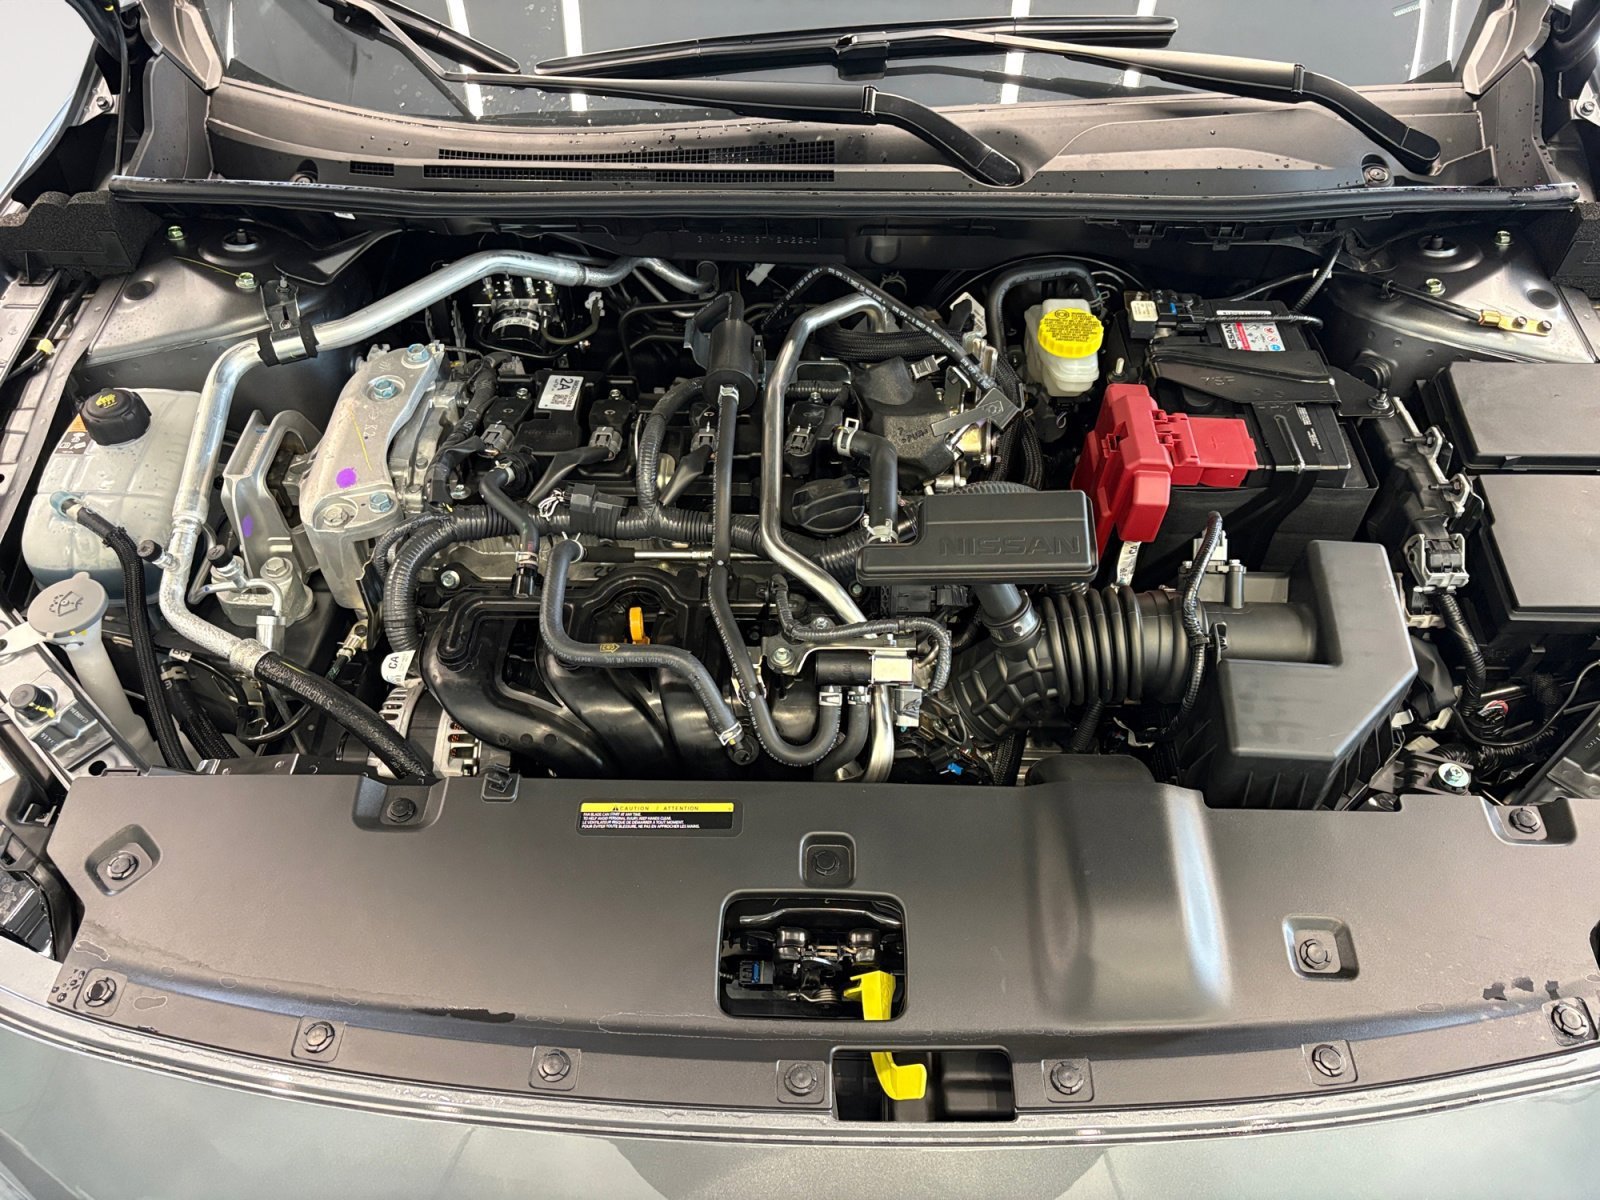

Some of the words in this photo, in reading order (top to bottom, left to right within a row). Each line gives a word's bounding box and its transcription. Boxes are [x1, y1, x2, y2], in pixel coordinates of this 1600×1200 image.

[557, 377, 574, 391] 2A
[938, 535, 1081, 557] NISSAN
[388, 655, 400, 670] CA
